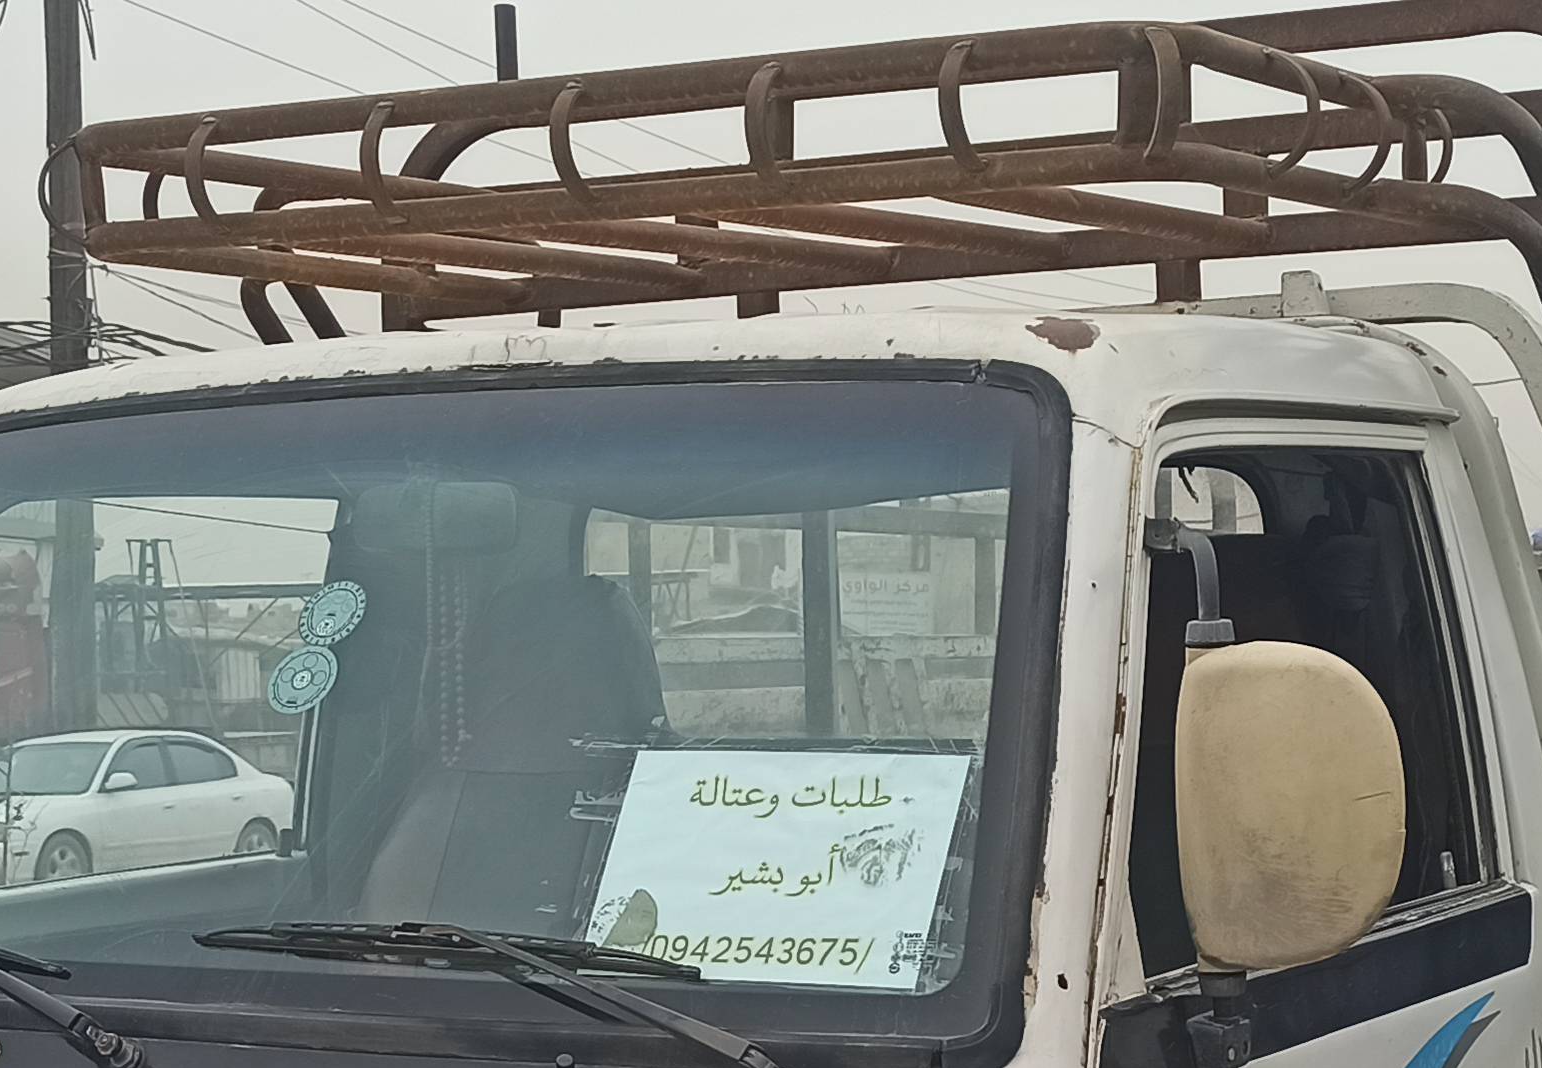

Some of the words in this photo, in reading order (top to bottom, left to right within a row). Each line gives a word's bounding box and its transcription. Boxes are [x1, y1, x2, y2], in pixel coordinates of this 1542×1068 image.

[690, 774, 780, 818] وعتالة
[791, 776, 893, 815] طلبات
[708, 862, 784, 896] بشير
[785, 842, 843, 896] أبو
